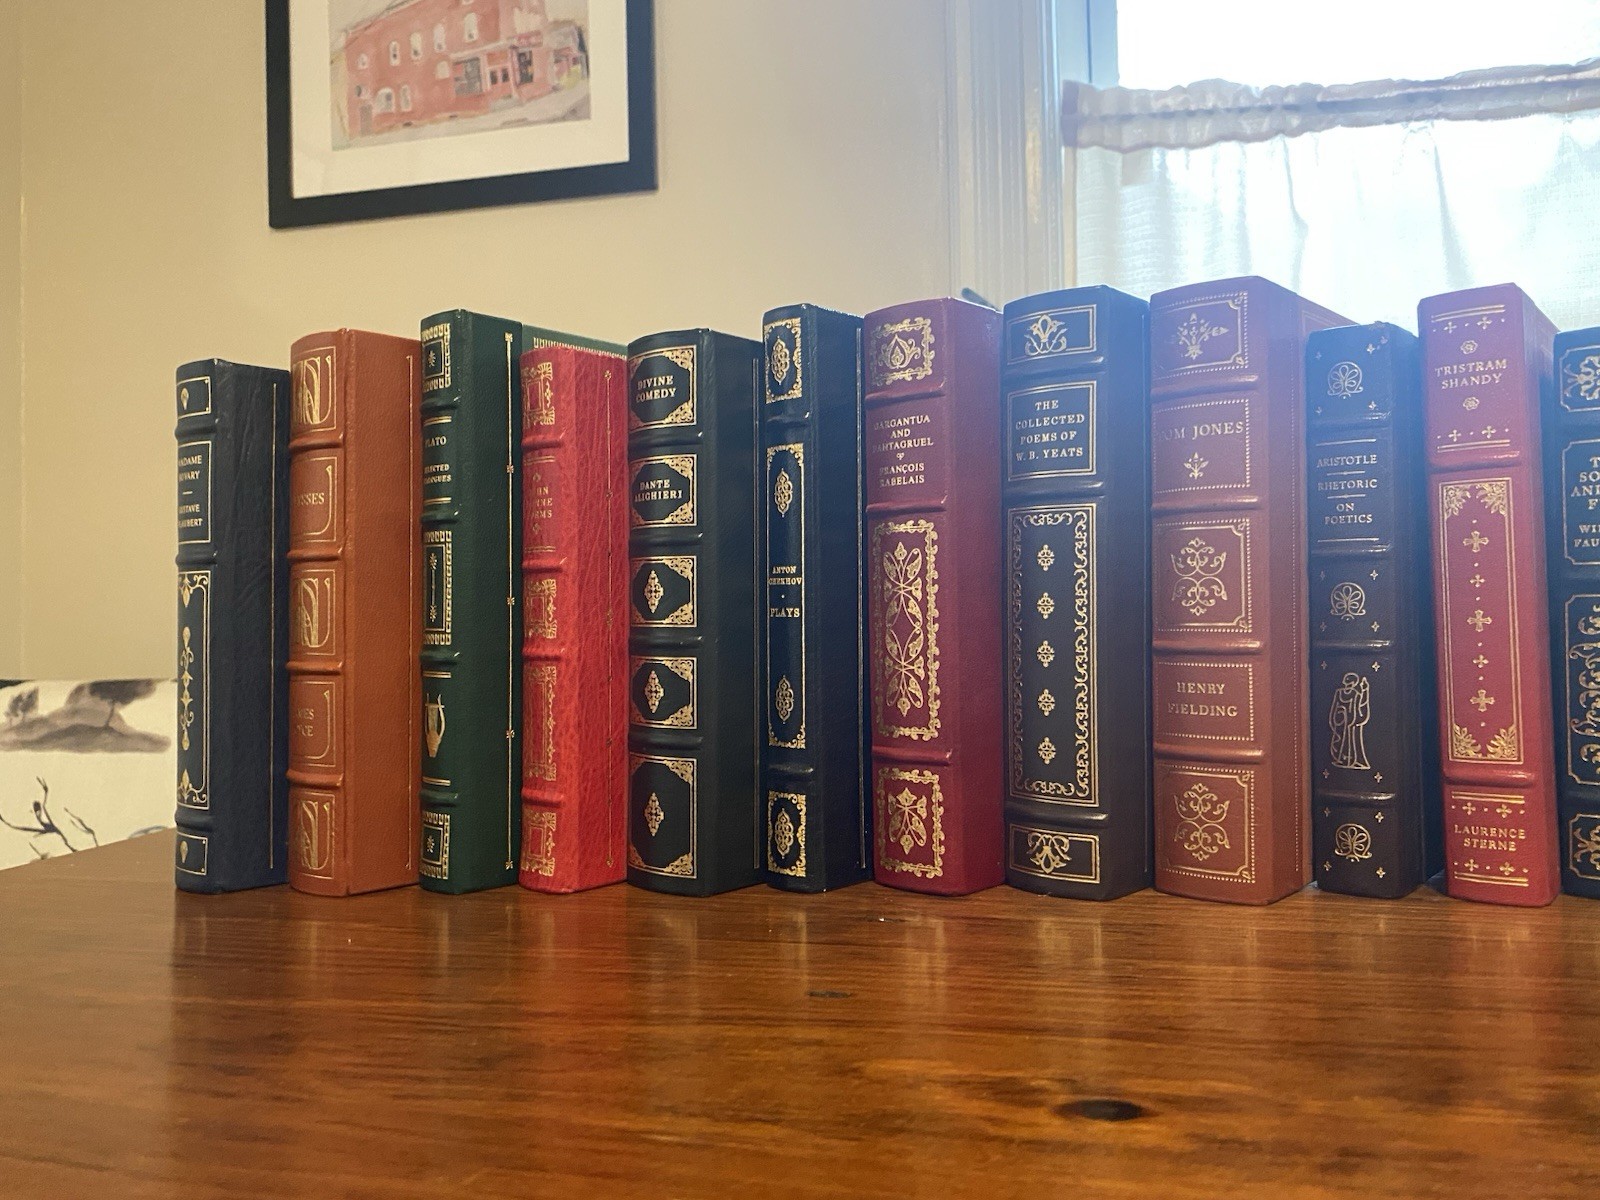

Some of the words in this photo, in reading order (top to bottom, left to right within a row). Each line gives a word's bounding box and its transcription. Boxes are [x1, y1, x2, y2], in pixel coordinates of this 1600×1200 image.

[1435, 359, 1507, 377] TRISTRAM
[638, 375, 674, 390] DIVINE
[1441, 373, 1502, 390] SHANDY
[636, 388, 676, 403] COMEDY
[1035, 399, 1059, 411] THE
[1016, 413, 1085, 430] COLLECTED
[891, 428, 911, 439] AND
[1192, 421, 1244, 440] JONES
[1021, 432, 1057, 445] POEMS
[1060, 430, 1077, 441] OF
[1029, 450, 1039, 460] B.
[1043, 447, 1084, 459] YEATS
[1317, 454, 1378, 468] ARISTOTLE
[640, 480, 671, 490] DANTE
[880, 475, 925, 487] RABELAIS
[1318, 479, 1378, 491] RHETORIC
[1336, 502, 1355, 512] ON
[1324, 514, 1373, 525] POETICS
[772, 566, 797, 574] ANTON
[769, 577, 802, 585] CHEKHOV
[770, 608, 800, 618] PLAYS
[1177, 682, 1225, 694] HENRY
[1168, 703, 1238, 717] FIELDING
[1454, 824, 1526, 839] LAURENCE
[1463, 838, 1517, 851] STERNE
